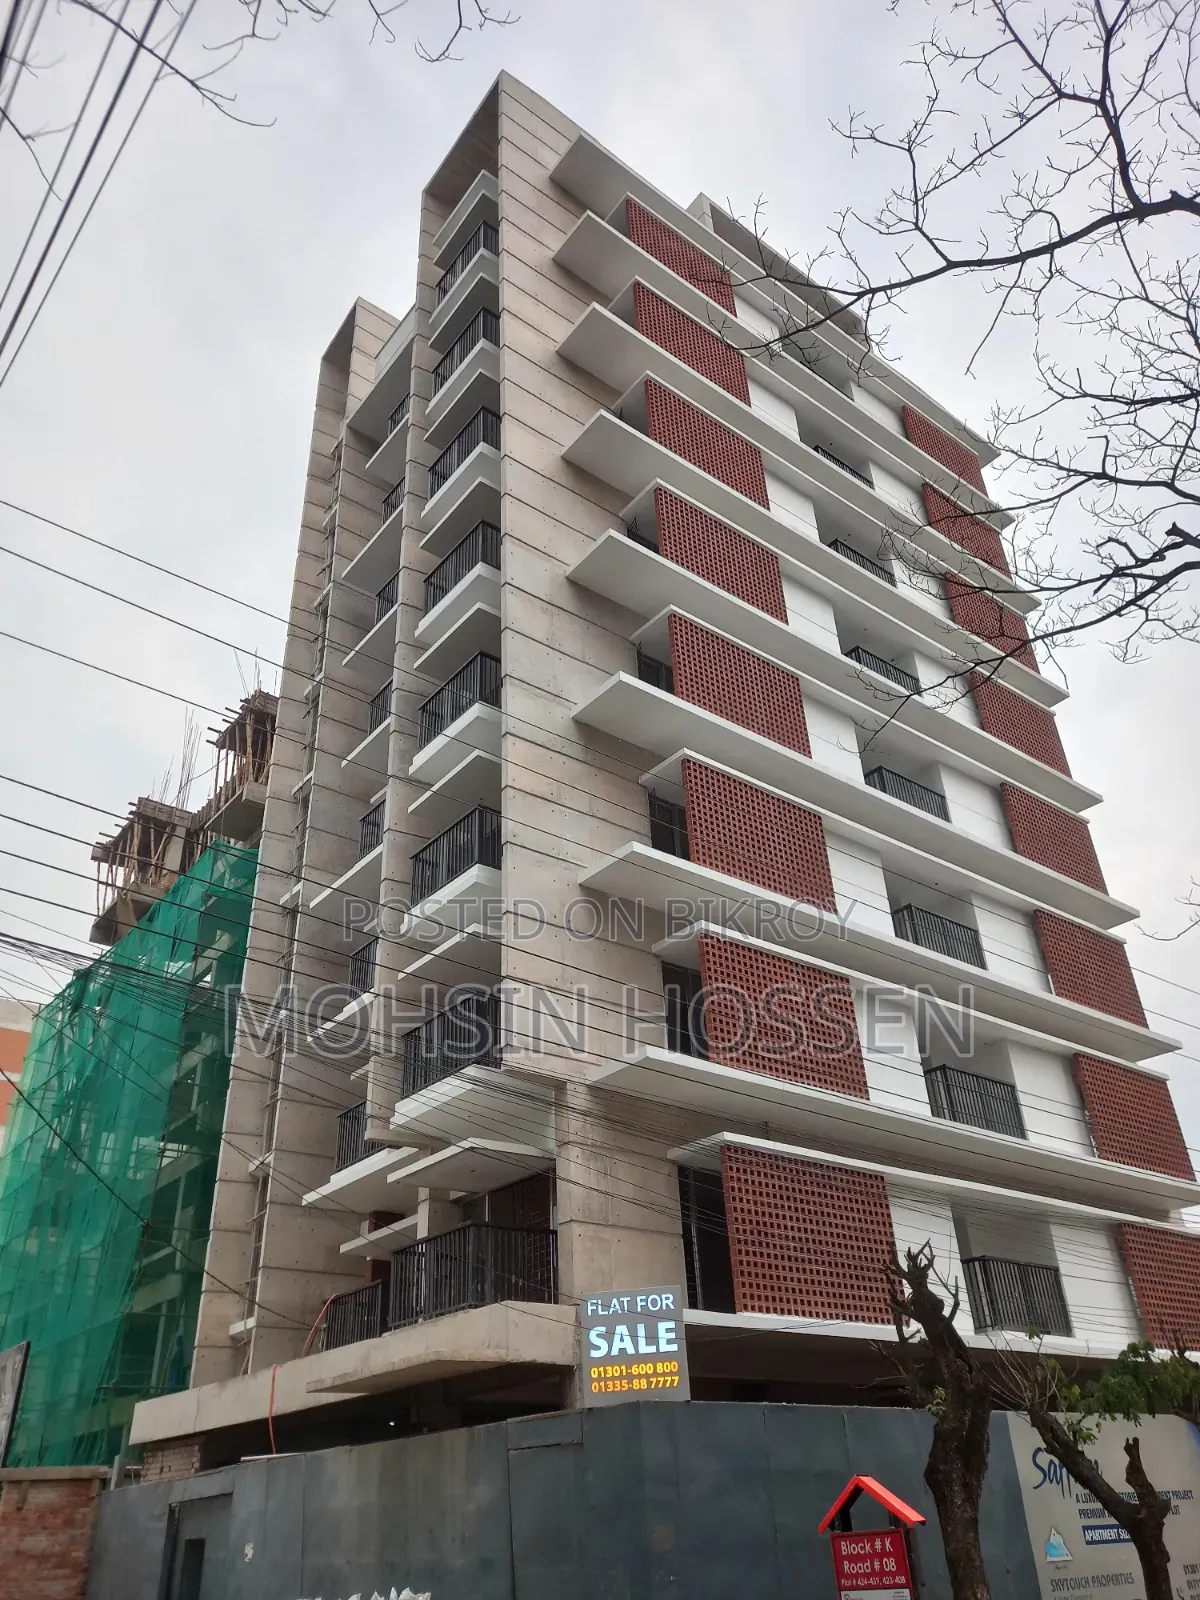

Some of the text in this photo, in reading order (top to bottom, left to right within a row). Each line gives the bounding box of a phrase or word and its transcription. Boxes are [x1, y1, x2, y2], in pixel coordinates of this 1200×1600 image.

[587, 1294, 675, 1316] FLAT FOR
[588, 1321, 679, 1358] SALE
[590, 1361, 679, 1378] 01301-600 800
[591, 1376, 679, 1393] 01335-88 7777
[1084, 1528, 1119, 1541] APARTMENT
[841, 1537, 893, 1555] Block # K
[843, 1557, 897, 1574] Road # 08
[1050, 1572, 1135, 1592] SKYTOUCH PROPERTIES
